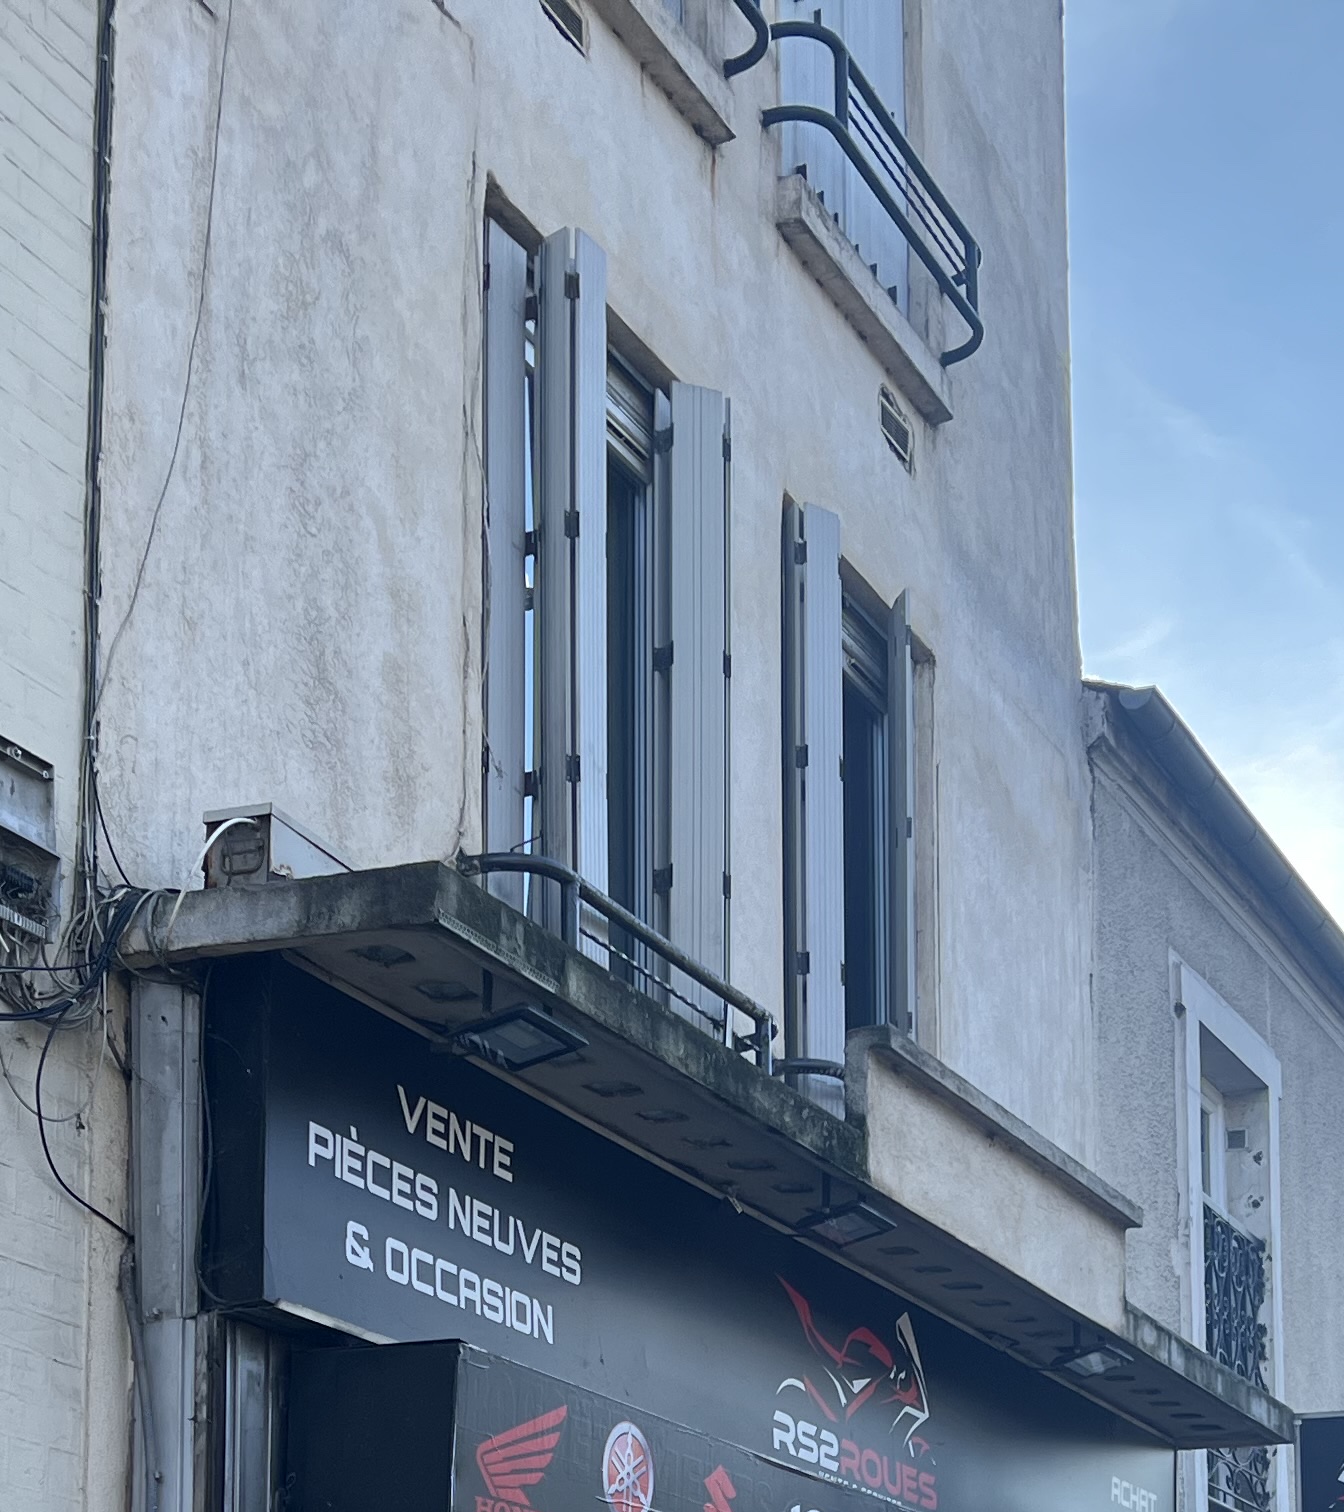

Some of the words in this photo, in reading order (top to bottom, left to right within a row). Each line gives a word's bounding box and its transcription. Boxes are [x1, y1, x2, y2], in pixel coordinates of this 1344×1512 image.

[396, 1084, 515, 1183] VENTE
[307, 1120, 439, 1222] PIÈCES
[447, 1187, 583, 1286] NEUVES
[345, 1219, 374, 1272] &
[385, 1238, 555, 1345] OCCASION
